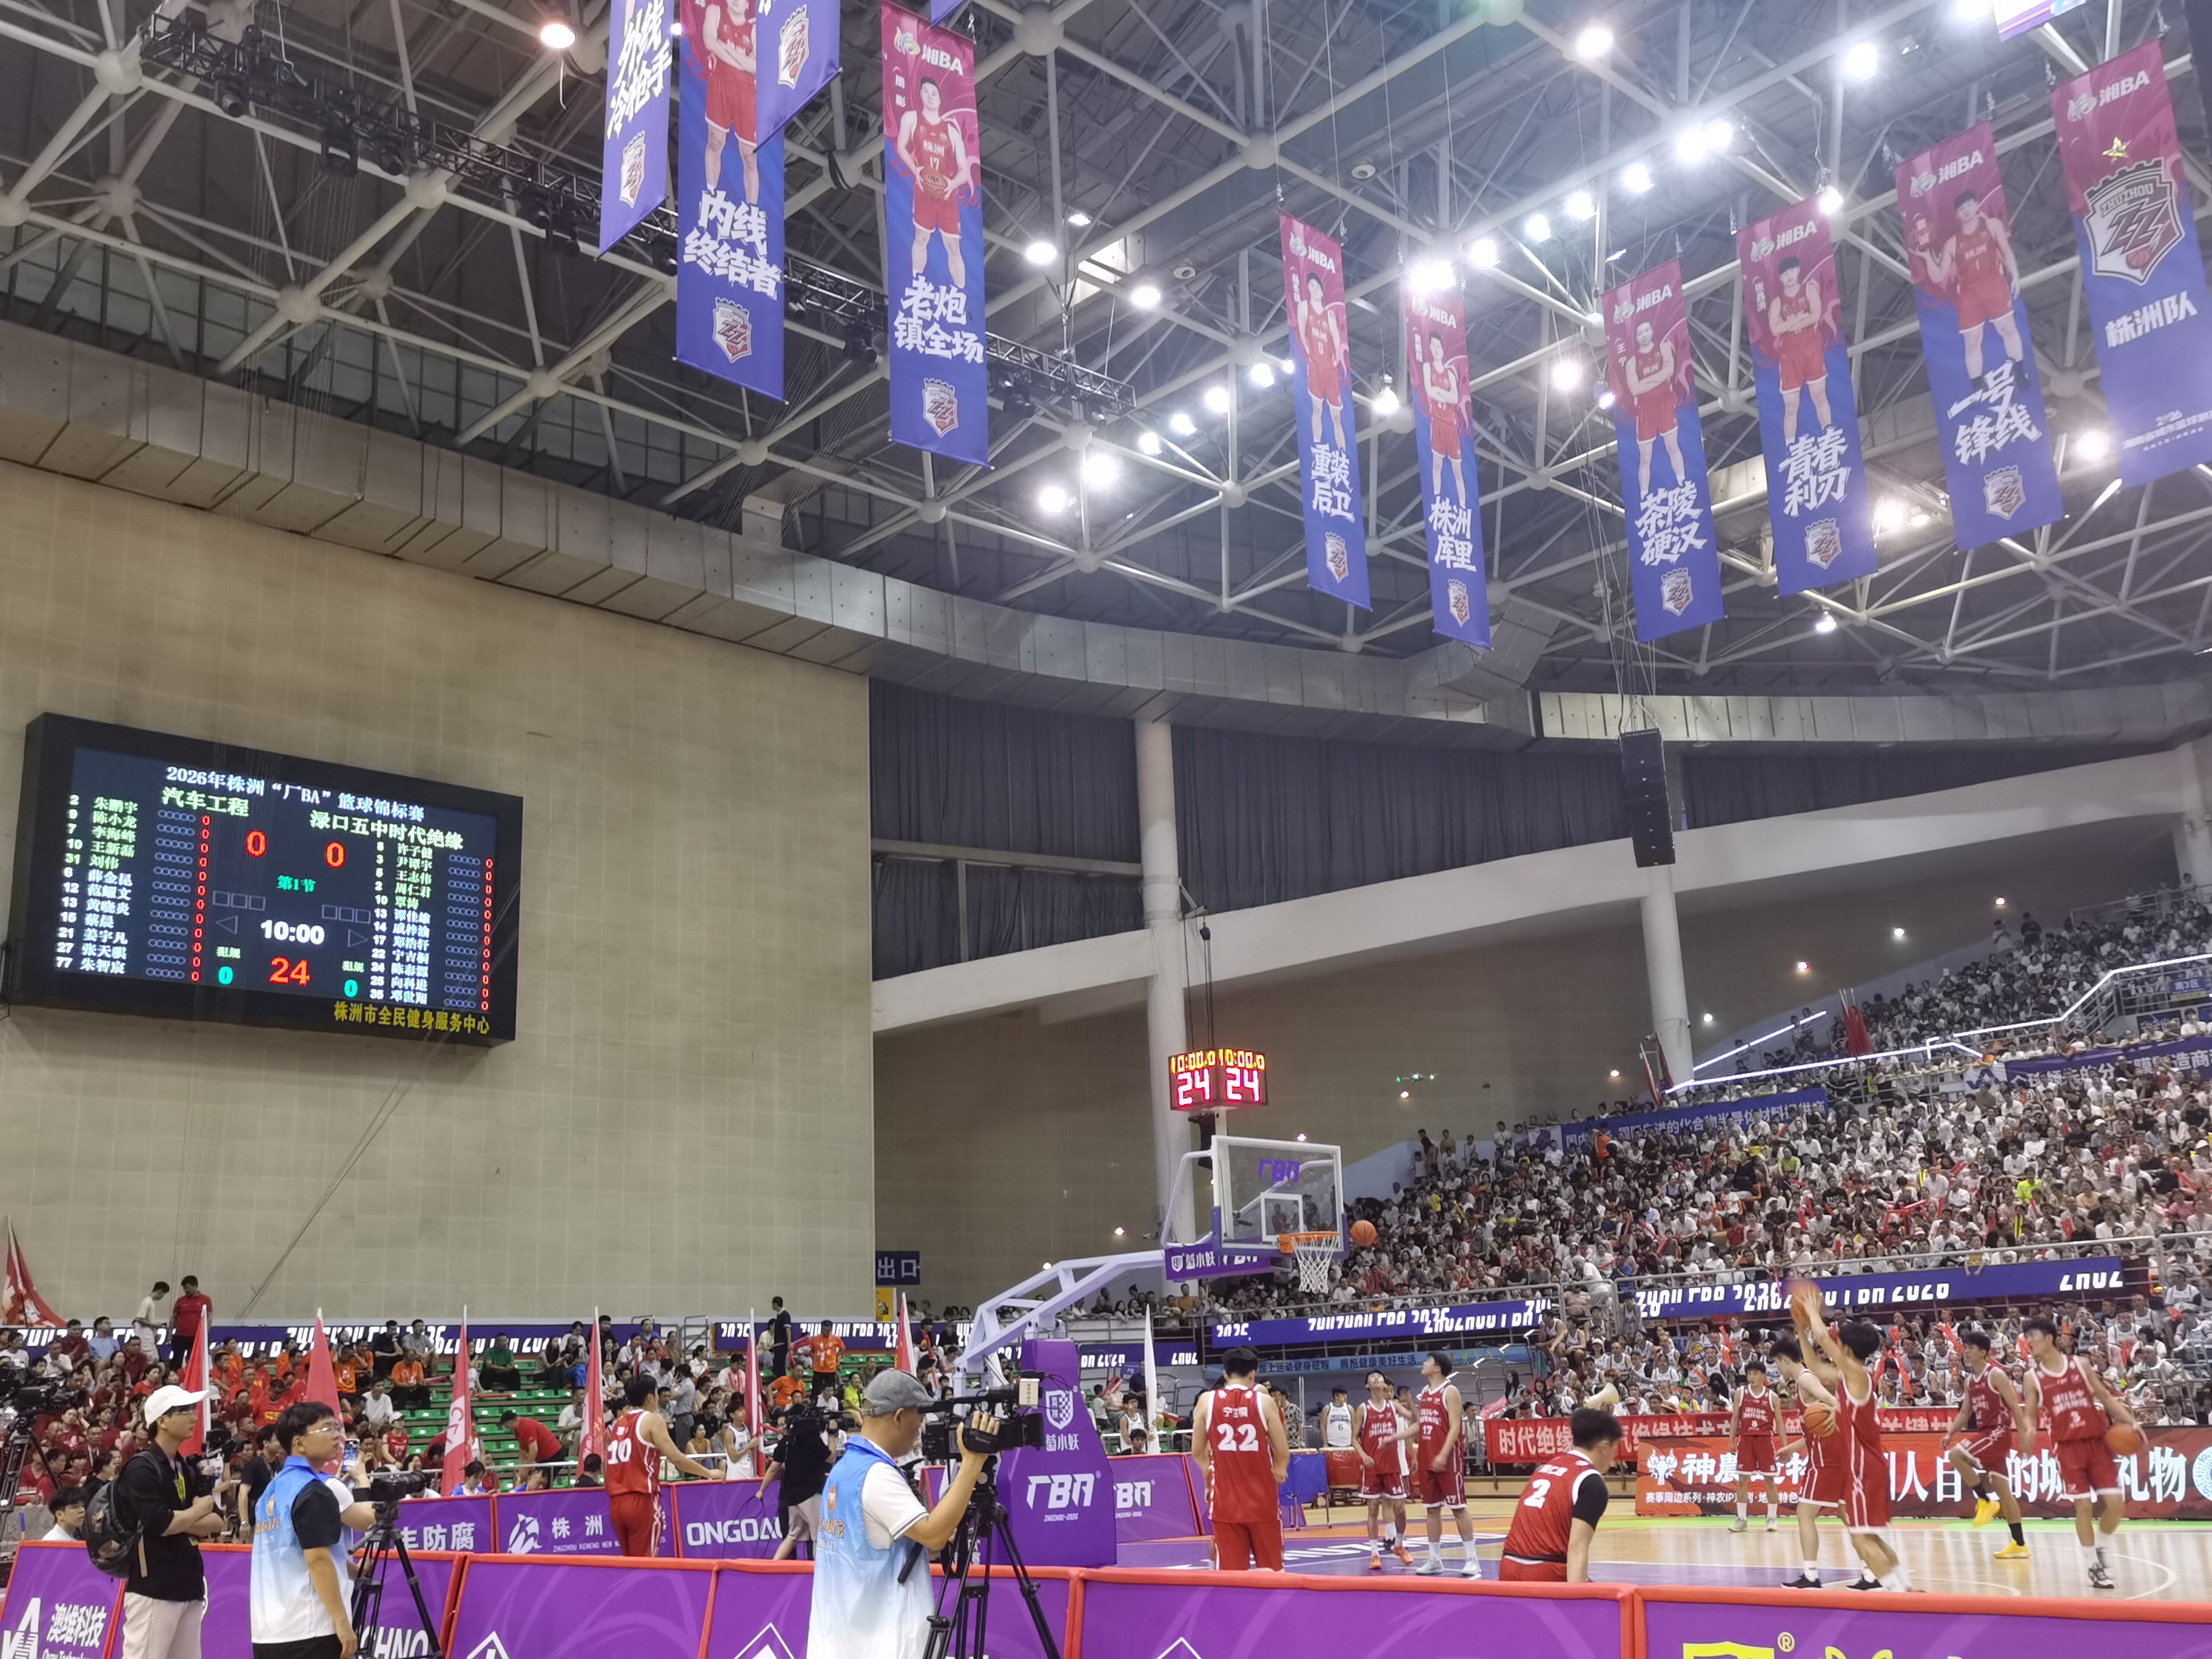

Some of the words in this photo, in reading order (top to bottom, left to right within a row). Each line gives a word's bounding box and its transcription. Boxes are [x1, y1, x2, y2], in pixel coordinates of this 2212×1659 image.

[2100, 183, 2154, 217] ZHUZHOU
[697, 190, 768, 256] 内线
[683, 227, 783, 300] 终结者
[900, 276, 967, 324] 老炮
[2105, 290, 2198, 348] 株洲队
[894, 312, 984, 363] 镇全场
[1310, 443, 1353, 493] 重装
[1778, 426, 1848, 483] 青春
[1312, 480, 1356, 523] 后卫
[1635, 480, 1703, 537] 茶陵
[1429, 496, 1472, 539] 株洲
[1435, 533, 1477, 572] 库里
[1640, 521, 1708, 566] 硬汉
[70, 794, 79, 805] 2
[203, 816, 210, 825] 0
[160, 786, 250, 817] 汽车工程
[67, 823, 77, 834] 7
[201, 843, 208, 853] 0
[202, 829, 209, 839] 0
[310, 809, 464, 850] 渌口五中时代绝缘
[66, 839, 83, 850] 10
[199, 857, 207, 867] 0
[246, 830, 268, 858] 0
[324, 840, 347, 869] 0
[199, 871, 206, 881] 0
[376, 854, 383, 865] 3
[486, 872, 492, 880] 0
[486, 859, 492, 868] 0
[62, 882, 79, 893] 12
[196, 900, 205, 910] 0
[198, 886, 205, 896] 0
[276, 875, 317, 893] 第1节
[375, 881, 383, 891] 2
[485, 898, 491, 907] 0
[486, 885, 491, 894] 0
[62, 896, 78, 908] 13
[196, 914, 203, 923] 0
[374, 908, 387, 919] 13
[484, 923, 490, 933] 0
[375, 894, 388, 905] 10
[484, 910, 491, 919] 0
[58, 927, 74, 939] 21
[193, 943, 201, 953] 0
[195, 928, 203, 938] 0
[260, 920, 325, 945] 10:00
[373, 935, 386, 945] 17
[483, 949, 490, 958] 0
[374, 921, 387, 932] 14
[484, 936, 490, 945] 0
[56, 942, 74, 953] 27
[193, 957, 200, 967] 0
[56, 956, 73, 968] 77
[192, 971, 199, 981] 0
[372, 948, 386, 959] 22
[483, 962, 489, 971] 0
[218, 966, 233, 985] 0
[269, 956, 310, 987] 24
[371, 962, 385, 972] 24
[483, 975, 488, 984] 0
[344, 979, 358, 997] 0
[483, 988, 488, 997] 0
[334, 1001, 490, 1034] 株洲市全民健身服务中心
[481, 1001, 488, 1010] 0
[1171, 1050, 1216, 1074] 10:00.0
[1219, 1048, 1265, 1070] 10:00.0
[1178, 1068, 1210, 1105] 24
[1226, 1067, 1260, 1102] 24
[877, 1256, 917, 1279] 出口
[1217, 1423, 1259, 1452] 22
[1423, 1426, 1433, 1435] 17
[1499, 1425, 1575, 1456] 时代绝缘
[608, 1438, 632, 1465] 10
[1113, 1481, 1151, 1509] BA
[1524, 1479, 1551, 1509] 2
[47, 1603, 107, 1648] 澳维科技
